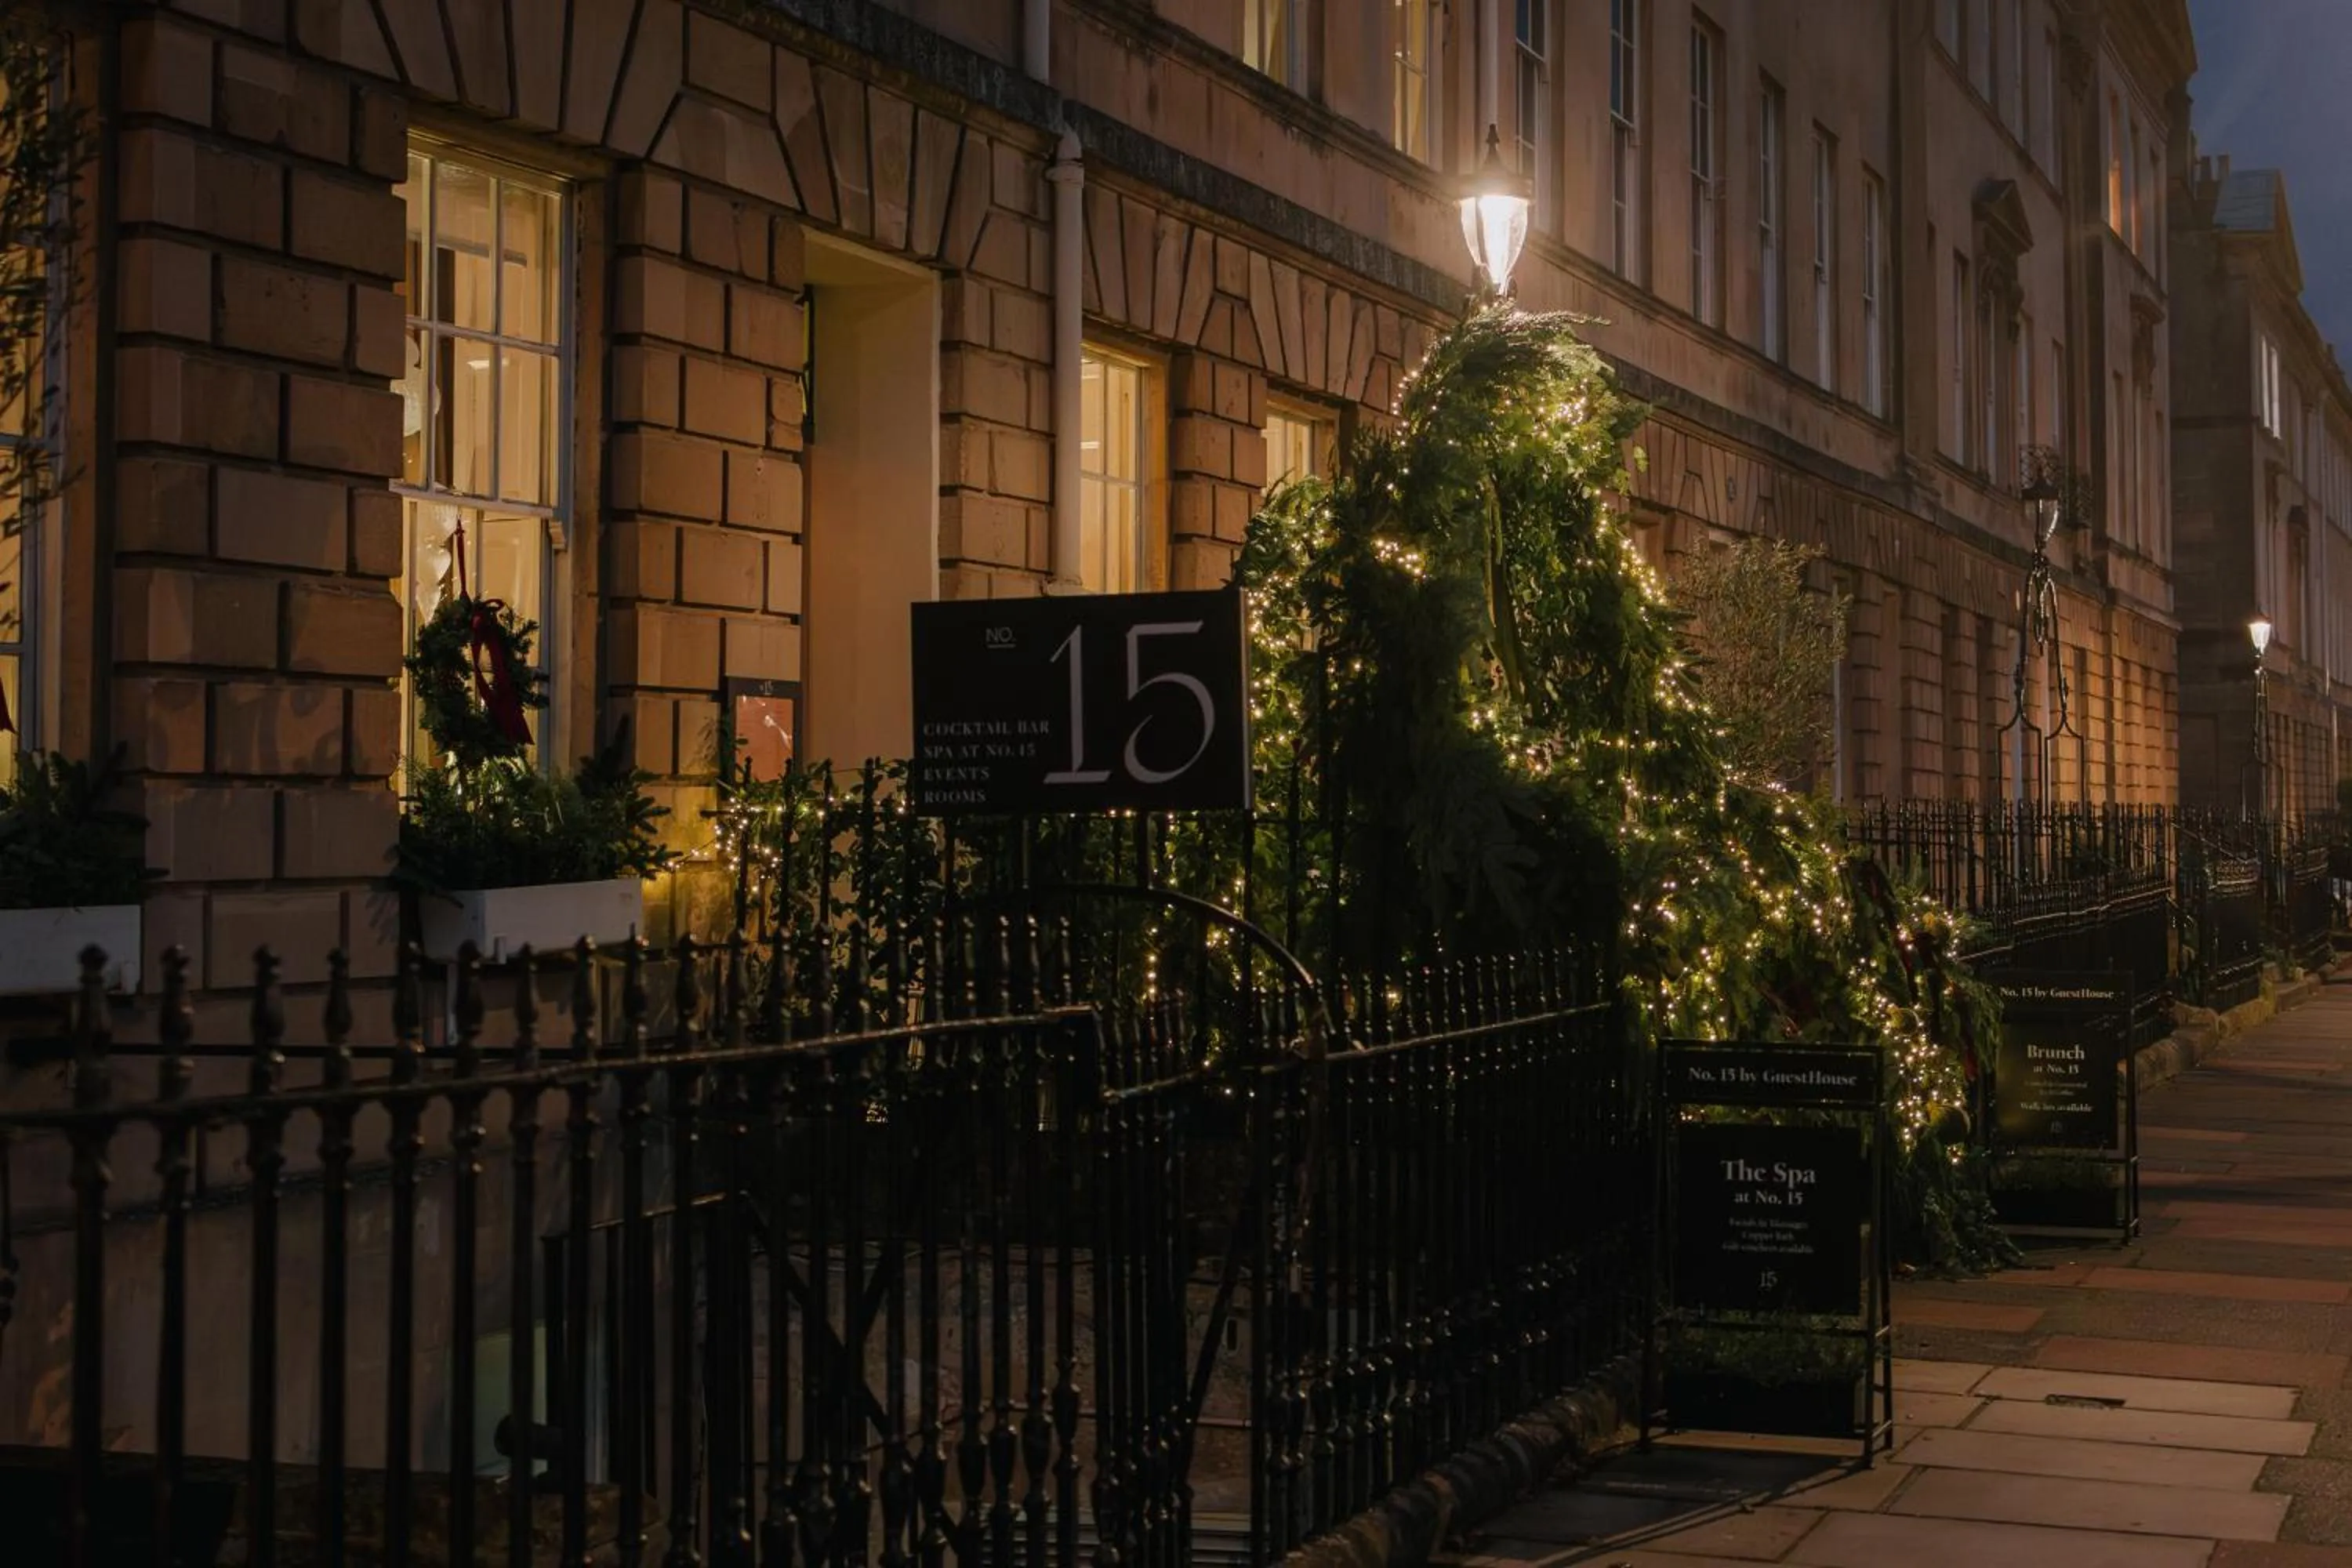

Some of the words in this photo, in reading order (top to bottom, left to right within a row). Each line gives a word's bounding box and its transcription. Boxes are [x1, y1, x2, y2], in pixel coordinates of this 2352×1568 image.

[1043, 619, 1216, 784] 15
[923, 720, 1013, 736] COCKTAIL
[1017, 719, 1050, 735] BAR
[923, 745, 954, 759] SPA
[958, 744, 981, 759] AT
[985, 742, 1016, 757] NO.
[1018, 742, 1036, 757] 15
[923, 766, 991, 782] EVENTS
[923, 789, 987, 804] ROOMS
[1999, 985, 2020, 998] No.
[2021, 986, 2033, 998] 15
[2034, 986, 2048, 1000] by
[2050, 987, 2115, 1000] GuestHouse
[2027, 1042, 2085, 1061] Brunch
[1687, 1066, 1716, 1082] No.
[1720, 1067, 1737, 1082] 15
[1739, 1066, 1757, 1083] by
[1762, 1069, 1857, 1087] GuestHouse
[2047, 1062, 2067, 1074] No.
[2068, 1063, 2080, 1075] 15
[1719, 1158, 1767, 1183] The
[1771, 1161, 1817, 1189] Spa
[1733, 1190, 1751, 1204] at
[1755, 1189, 1782, 1205] No.
[1787, 1190, 1804, 1206] 15
[1759, 1269, 1779, 1290] 15
